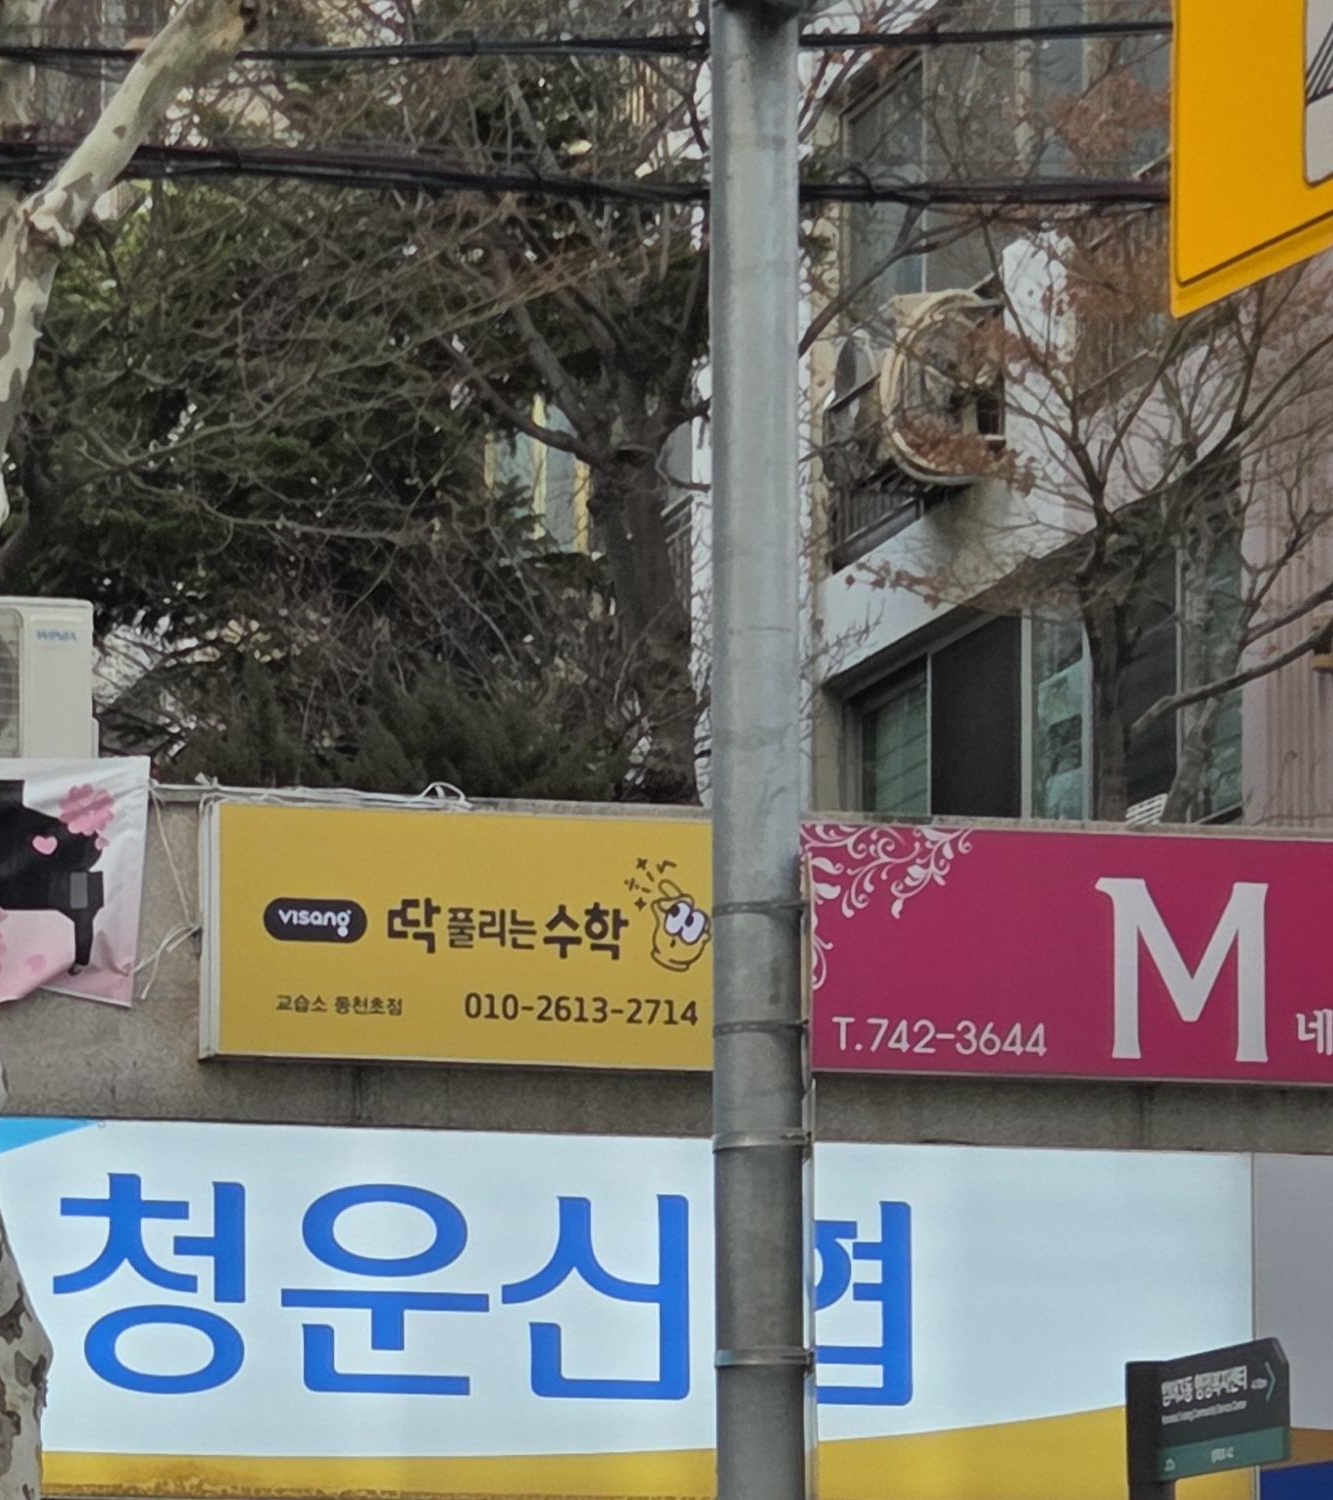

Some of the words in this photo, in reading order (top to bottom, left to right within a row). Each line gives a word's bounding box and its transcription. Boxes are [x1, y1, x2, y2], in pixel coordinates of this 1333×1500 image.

[277, 907, 352, 938] visang
[1095, 876, 1269, 1063] M
[275, 994, 329, 1015] 교습소
[463, 992, 699, 1028] 010-2613-2714
[832, 1016, 1048, 1057] T.742-3644
[51, 1172, 913, 1407] 청운신협
